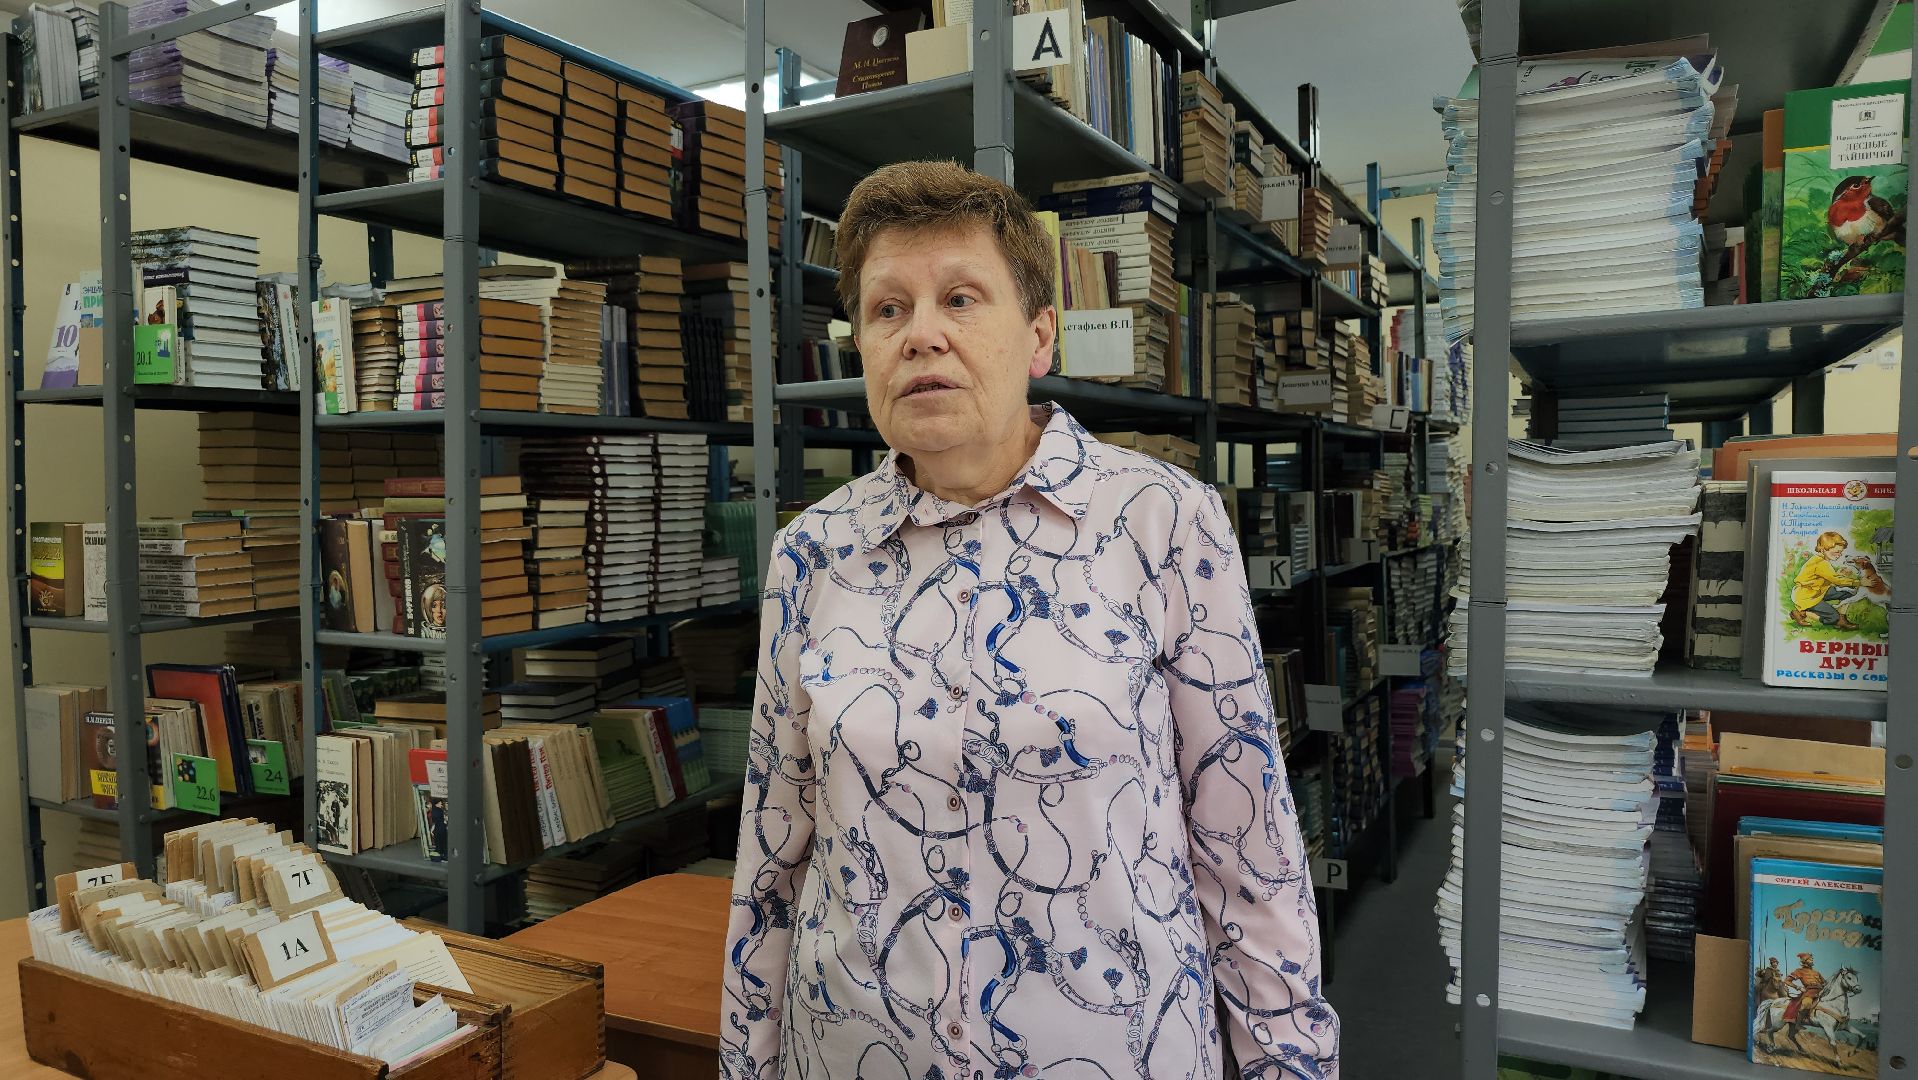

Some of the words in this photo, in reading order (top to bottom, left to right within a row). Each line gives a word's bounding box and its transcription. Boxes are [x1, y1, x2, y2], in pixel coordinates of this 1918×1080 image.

[1032, 17, 1063, 61] А
[53, 324, 78, 348] 10
[136, 351, 153, 366] 20.1
[1270, 559, 1287, 586] К
[1819, 656, 1879, 671] ДРУГ
[263, 768, 284, 783] 24
[196, 785, 216, 802] 22.6
[1775, 877, 1809, 886] СЕРГЕЙ
[1814, 881, 1864, 891] АЛЕКСЕЕВ
